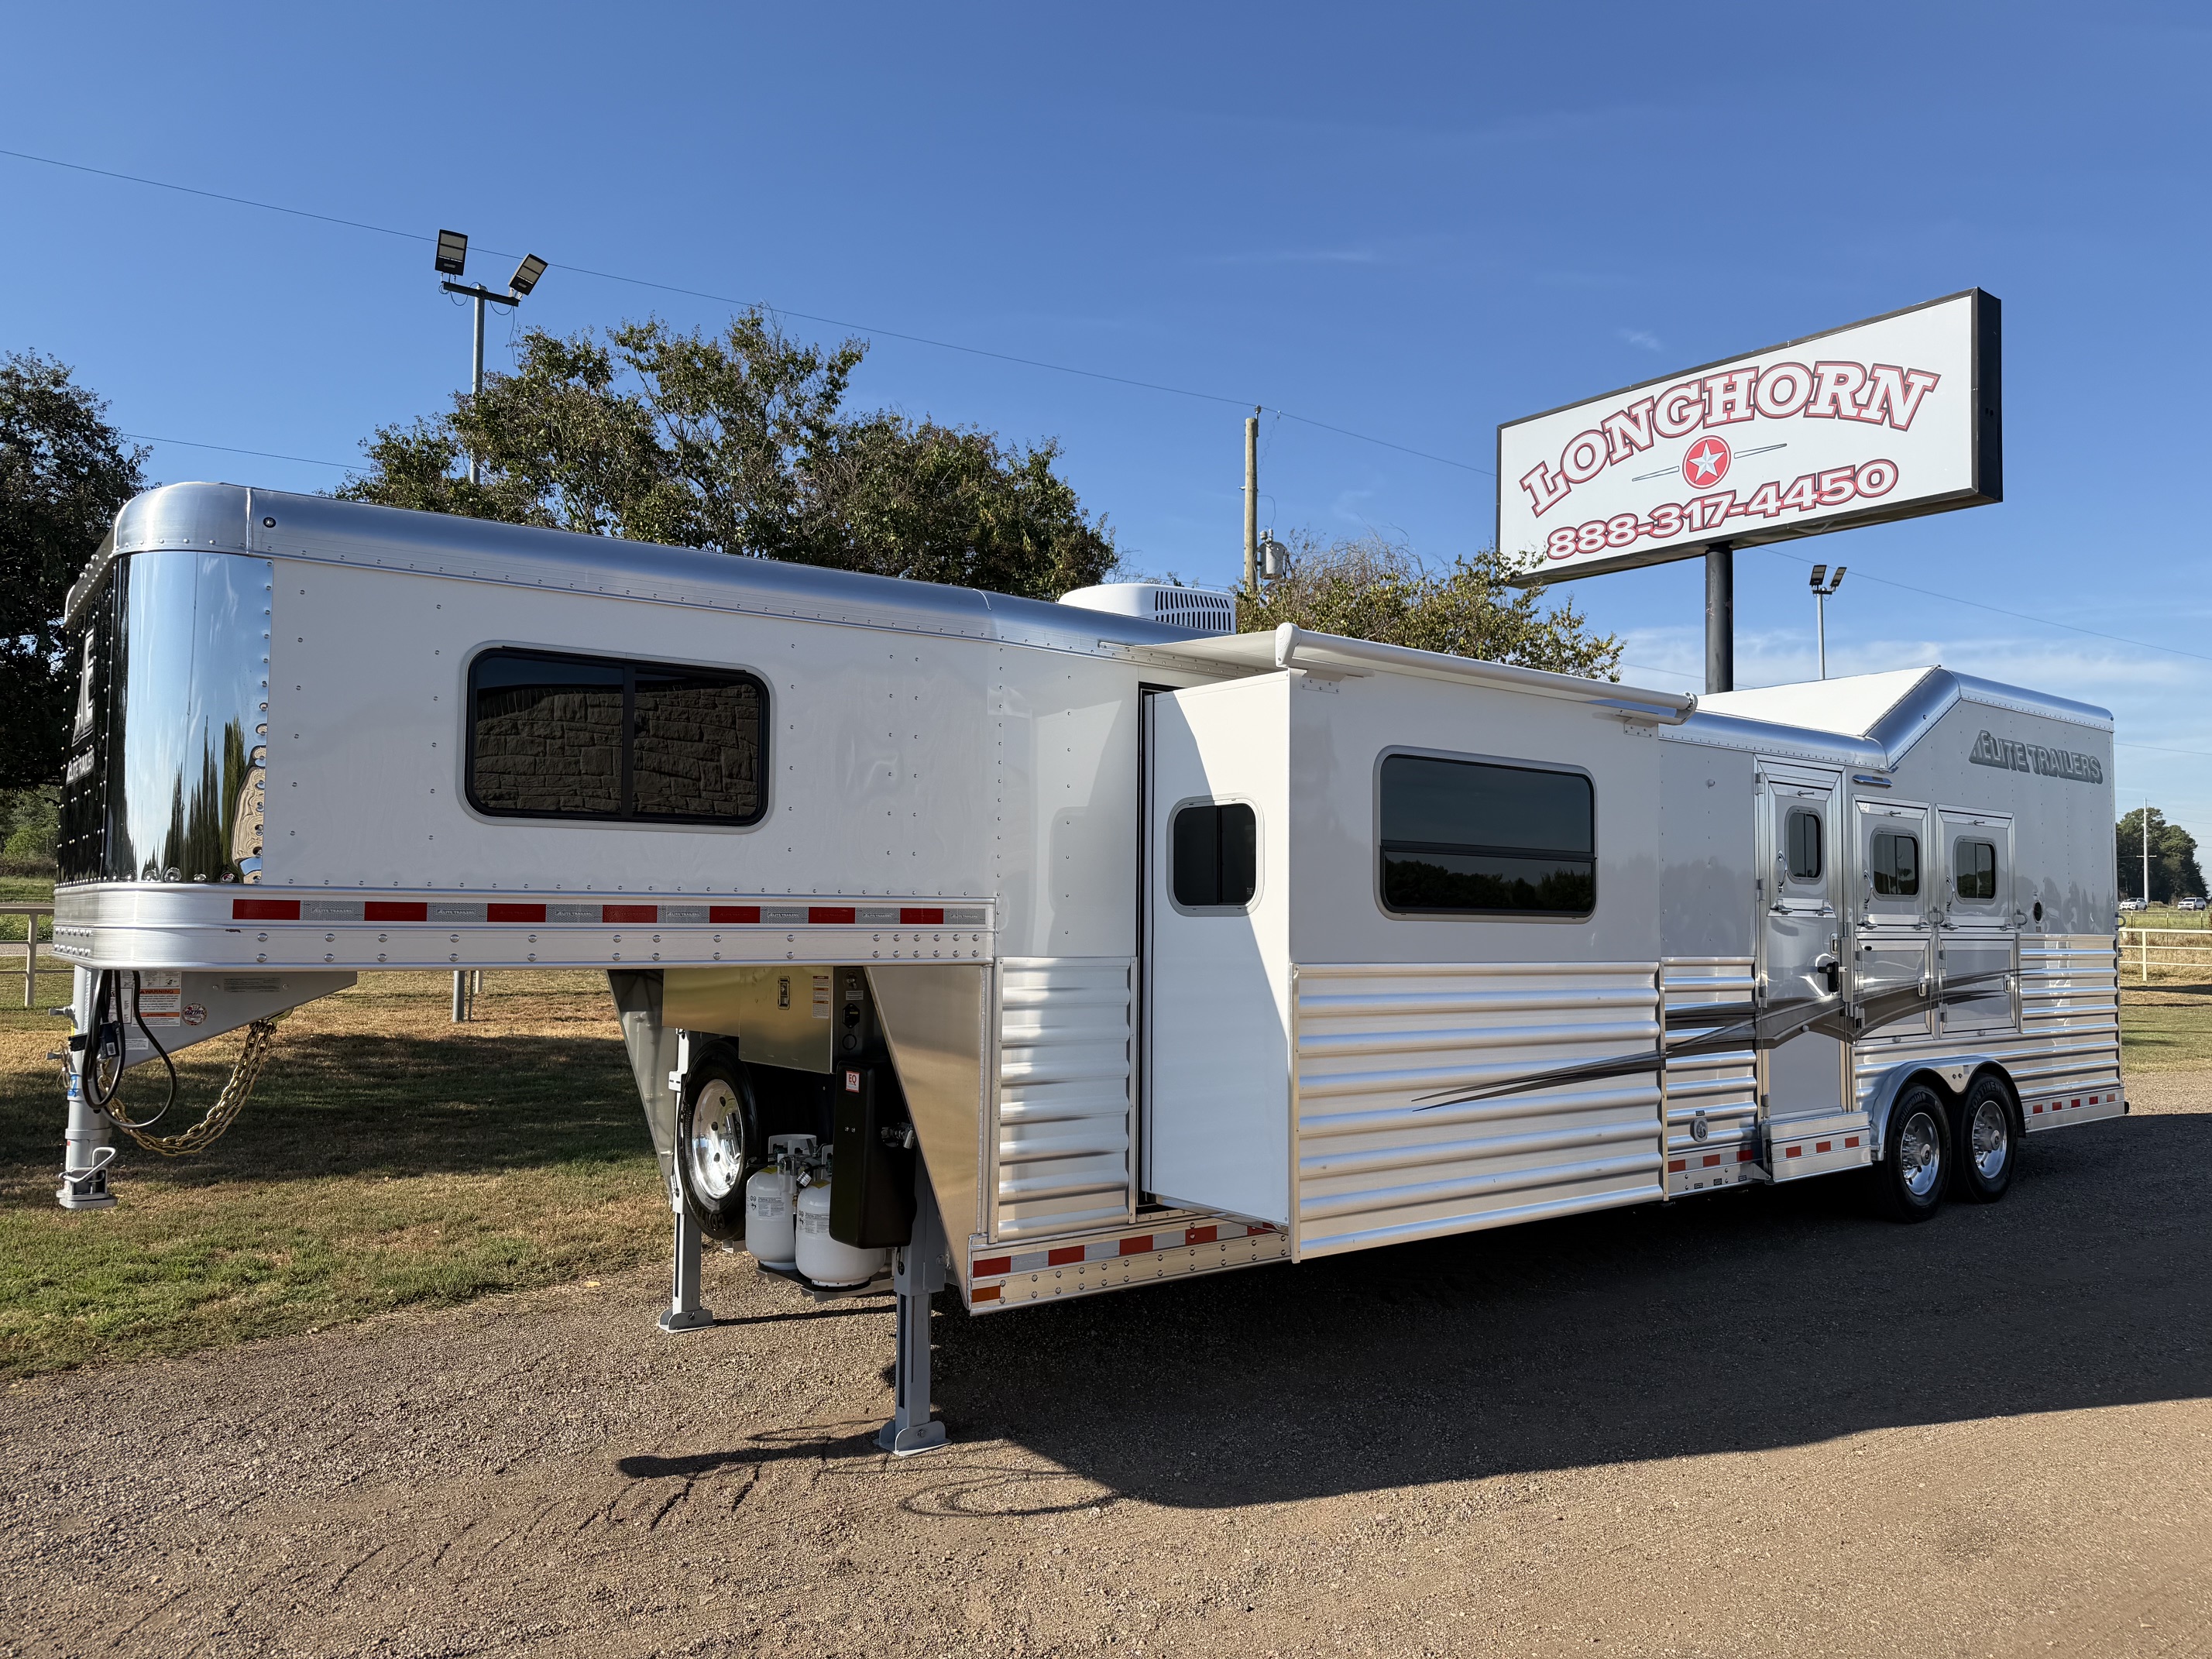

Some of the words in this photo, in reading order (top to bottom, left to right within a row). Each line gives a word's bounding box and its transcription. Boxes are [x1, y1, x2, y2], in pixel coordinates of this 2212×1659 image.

[1519, 361, 1942, 518] LONGHORN
[1545, 459, 1899, 560] 888-317-4450
[2026, 744, 2103, 785] TRAILERS
[848, 1073, 857, 1087] EQ
